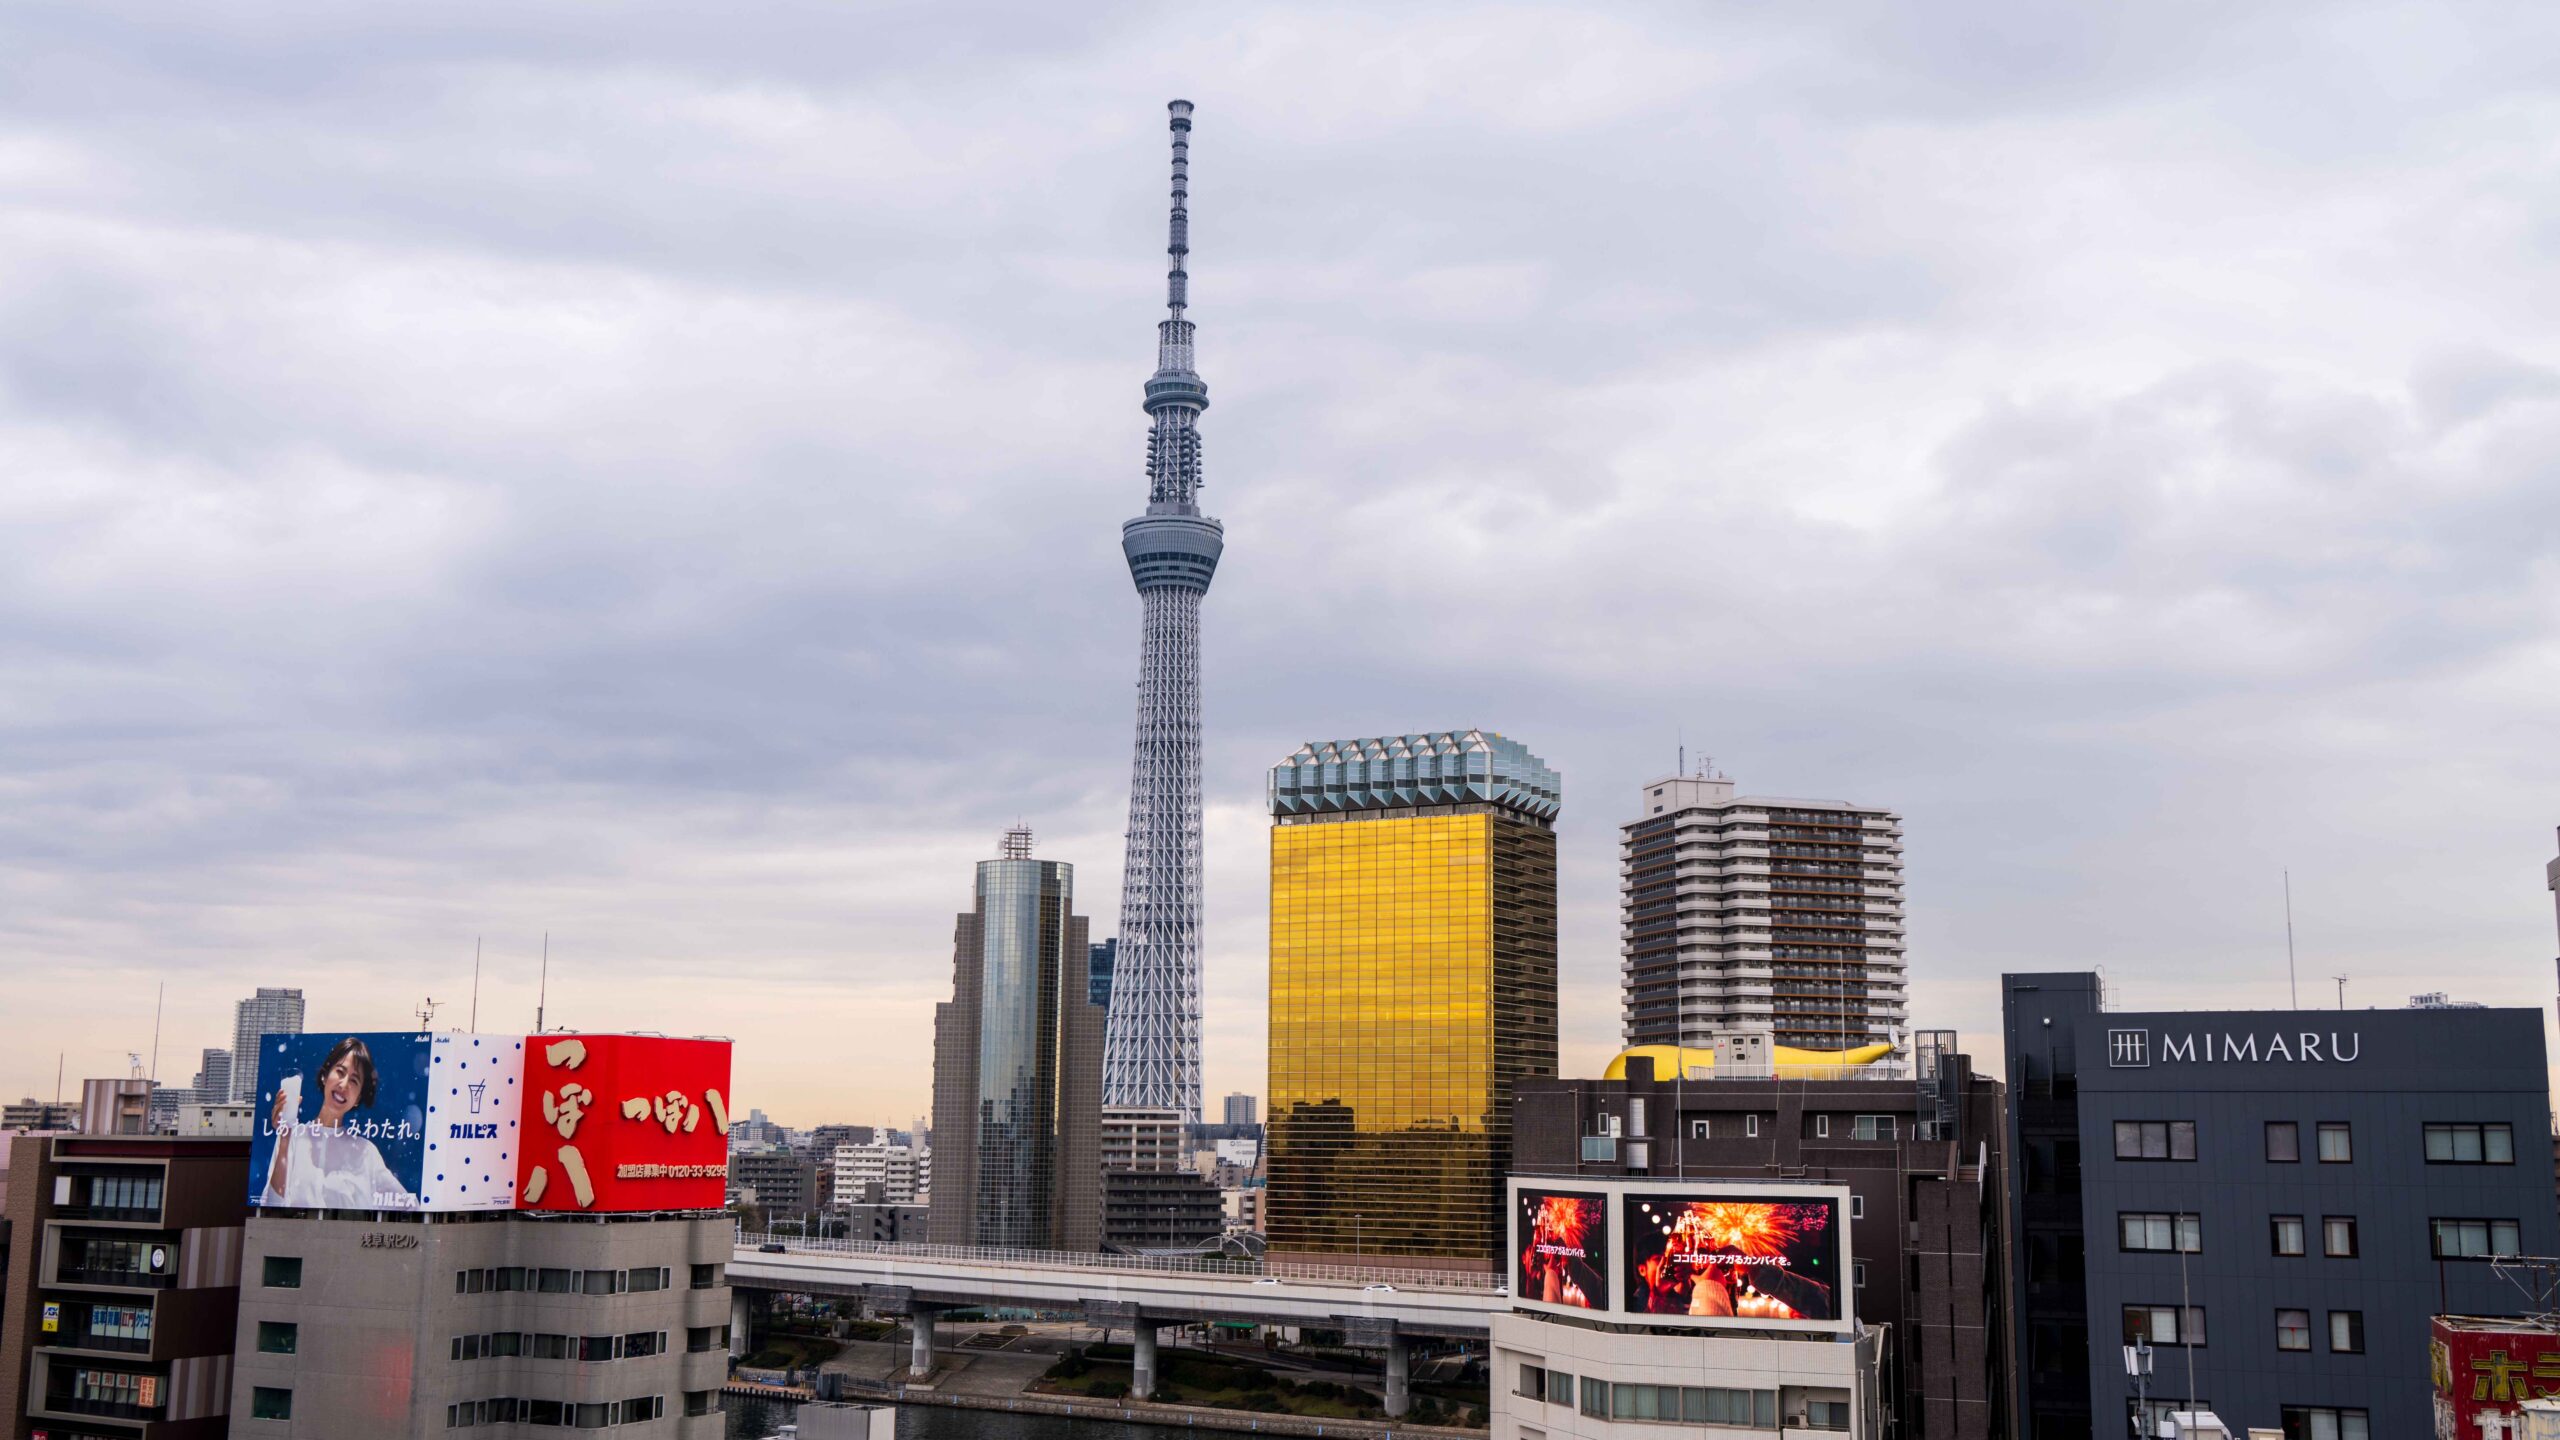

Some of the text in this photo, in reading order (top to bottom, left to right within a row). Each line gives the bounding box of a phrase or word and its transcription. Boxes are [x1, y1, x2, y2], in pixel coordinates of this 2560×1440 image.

[2162, 1032, 2359, 1062] MIMARU
[621, 1088, 729, 1136] つぼ八
[262, 1118, 421, 1141] しあわせ、しみわたれ。
[450, 1123, 498, 1139] カルピス
[372, 1191, 418, 1208] カルピス
[360, 1231, 419, 1248] 浅草駅ビル
